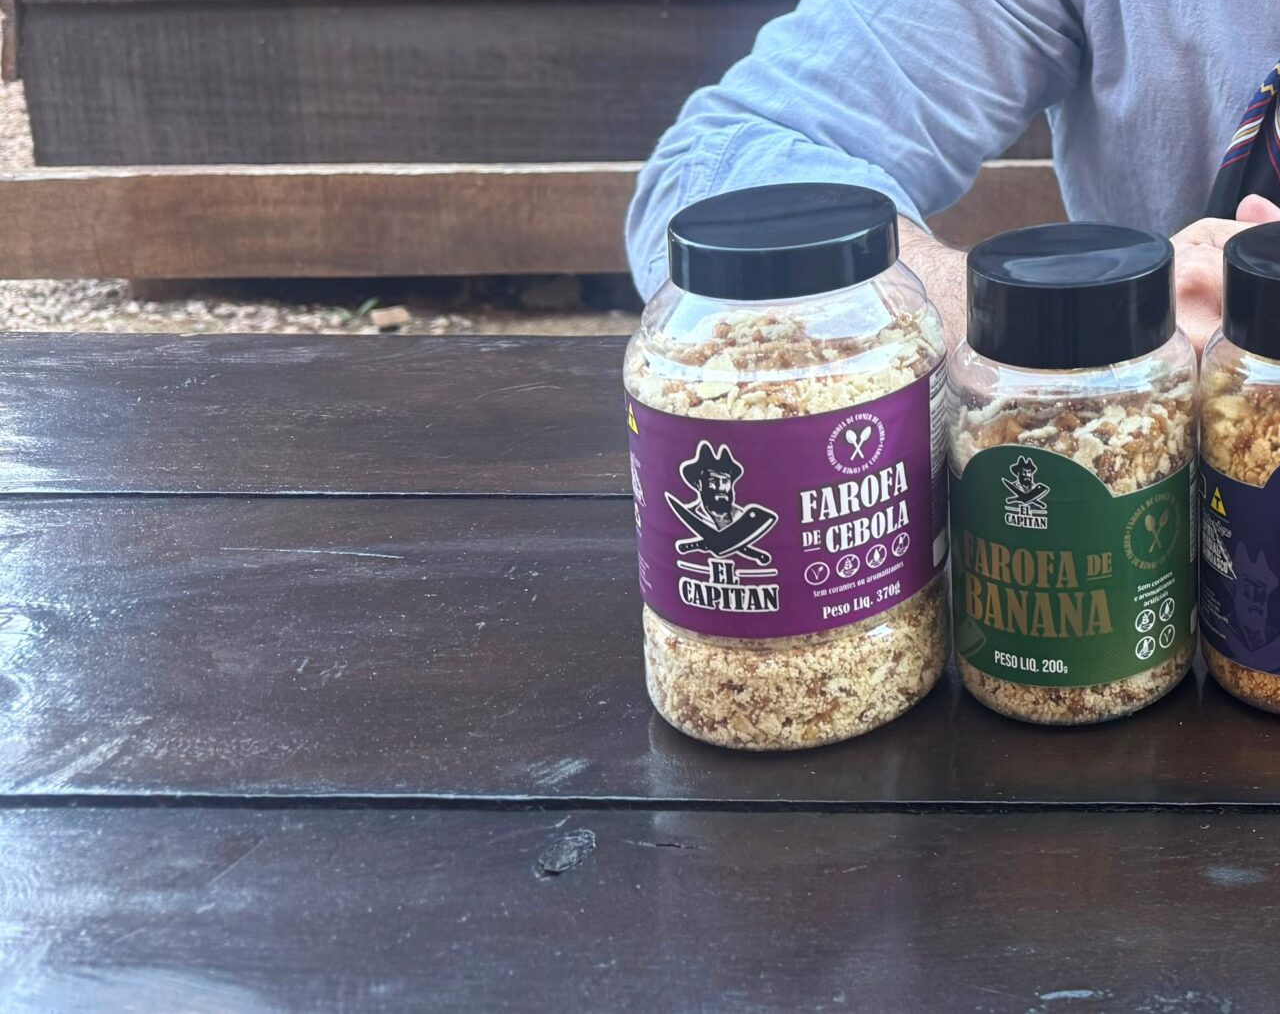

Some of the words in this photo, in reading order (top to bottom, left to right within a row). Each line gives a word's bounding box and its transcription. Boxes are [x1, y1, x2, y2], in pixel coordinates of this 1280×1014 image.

[801, 462, 908, 523] FAROFA
[1005, 513, 1047, 529] CAPITAN
[1020, 505, 1032, 516] EL
[802, 530, 821, 547] DE
[826, 500, 909, 553] CEBOLA
[710, 560, 738, 585] EL
[963, 530, 1078, 588] FAROFA
[1087, 552, 1112, 575] DE
[682, 579, 778, 610] CAPITAN
[813, 589, 827, 597] Sem
[828, 582, 856, 594] corantes
[823, 603, 850, 619] Peso
[854, 595, 873, 610] Liq.
[876, 580, 900, 602] 370g
[1138, 582, 1150, 592] Sem
[965, 571, 1113, 638] BANANA
[994, 650, 1018, 669] PESO
[1020, 658, 1039, 672] LIQ.
[1042, 660, 1068, 673] 200g
